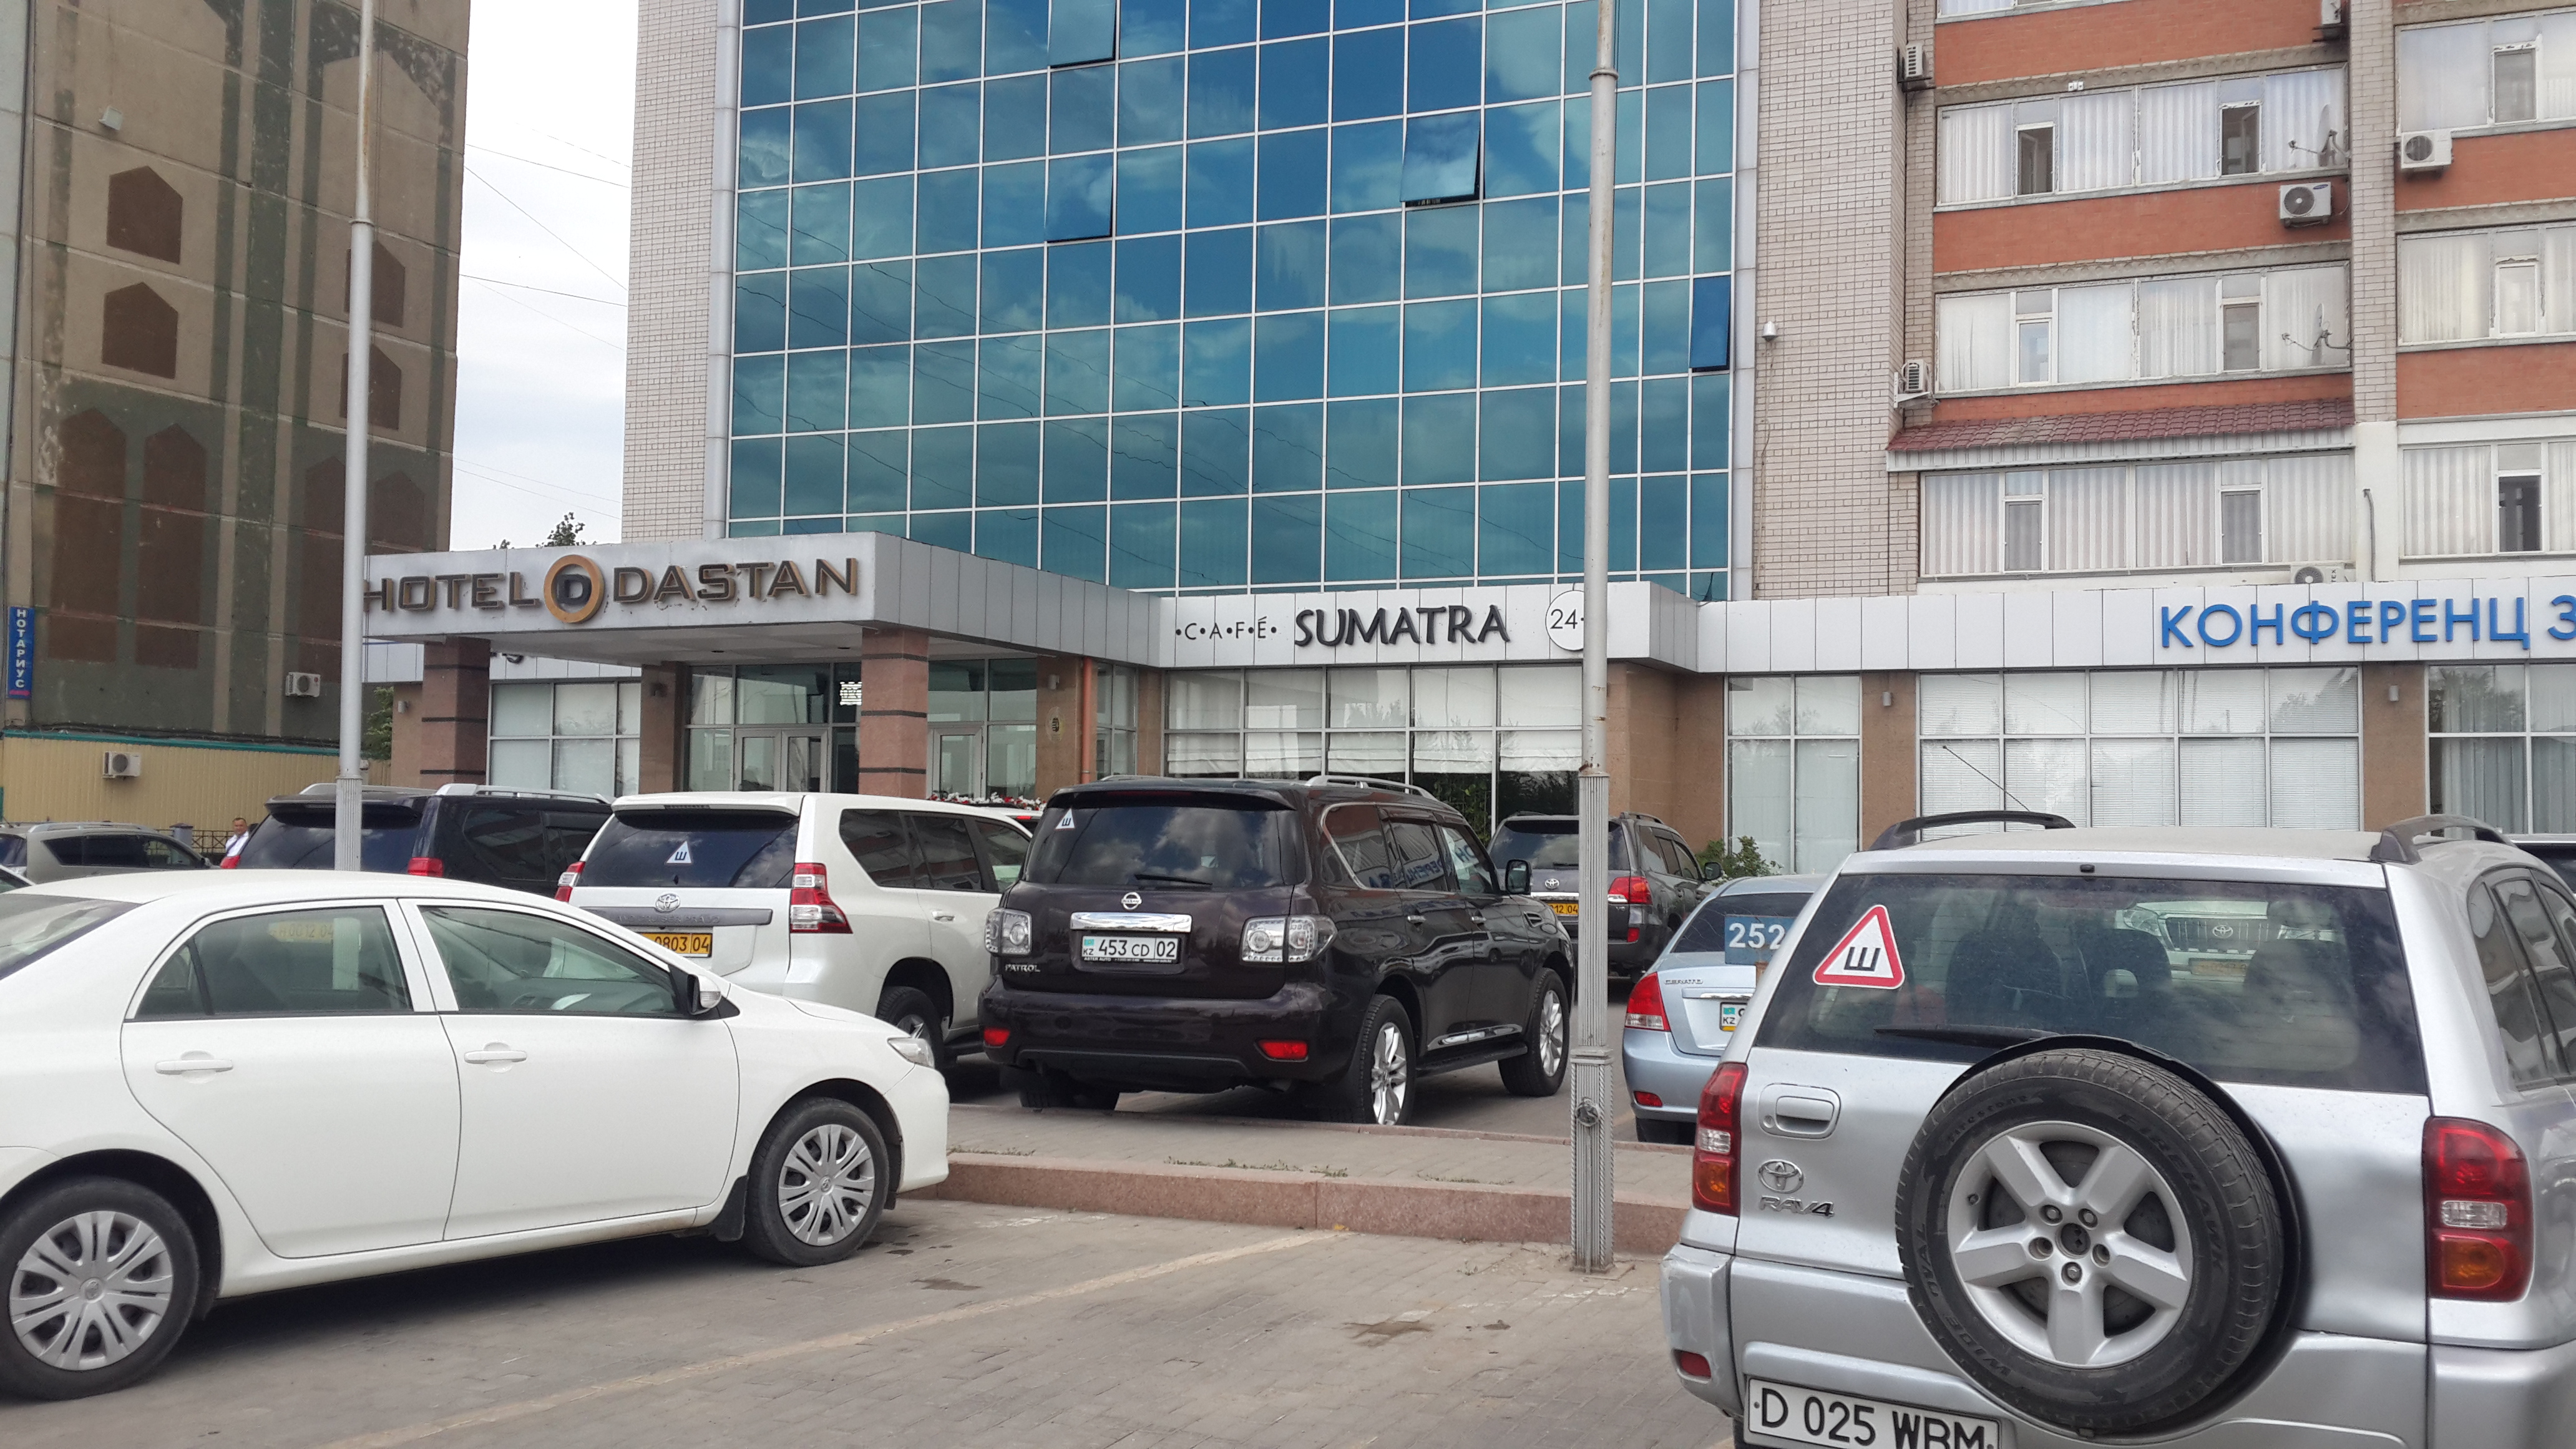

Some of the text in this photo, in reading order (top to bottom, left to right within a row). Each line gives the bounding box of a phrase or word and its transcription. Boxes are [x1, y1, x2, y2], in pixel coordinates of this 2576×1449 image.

[363, 572, 540, 612] HOTEL
[612, 557, 857, 604] DASTAN
[1294, 604, 1511, 646] SUMATRA
[2161, 597, 2530, 650] КОНФЕРЕНЦ
[15, 608, 27, 688] НОТАРИУС
[1061, 817, 1071, 826] Ш
[675, 851, 687, 861] Ш
[1551, 905, 1578, 914] 12 04
[693, 936, 710, 952] 04
[1729, 922, 1785, 950] 252
[1083, 939, 1176, 958] KZ 453 CD 02
[1843, 946, 1881, 972] Ш
[1005, 964, 1041, 972] PATROL
[1723, 1017, 1735, 1025] KZ
[1760, 1195, 1835, 1219] RAV4
[1762, 1387, 1789, 1428] D
[1803, 1396, 1876, 1447] 025
